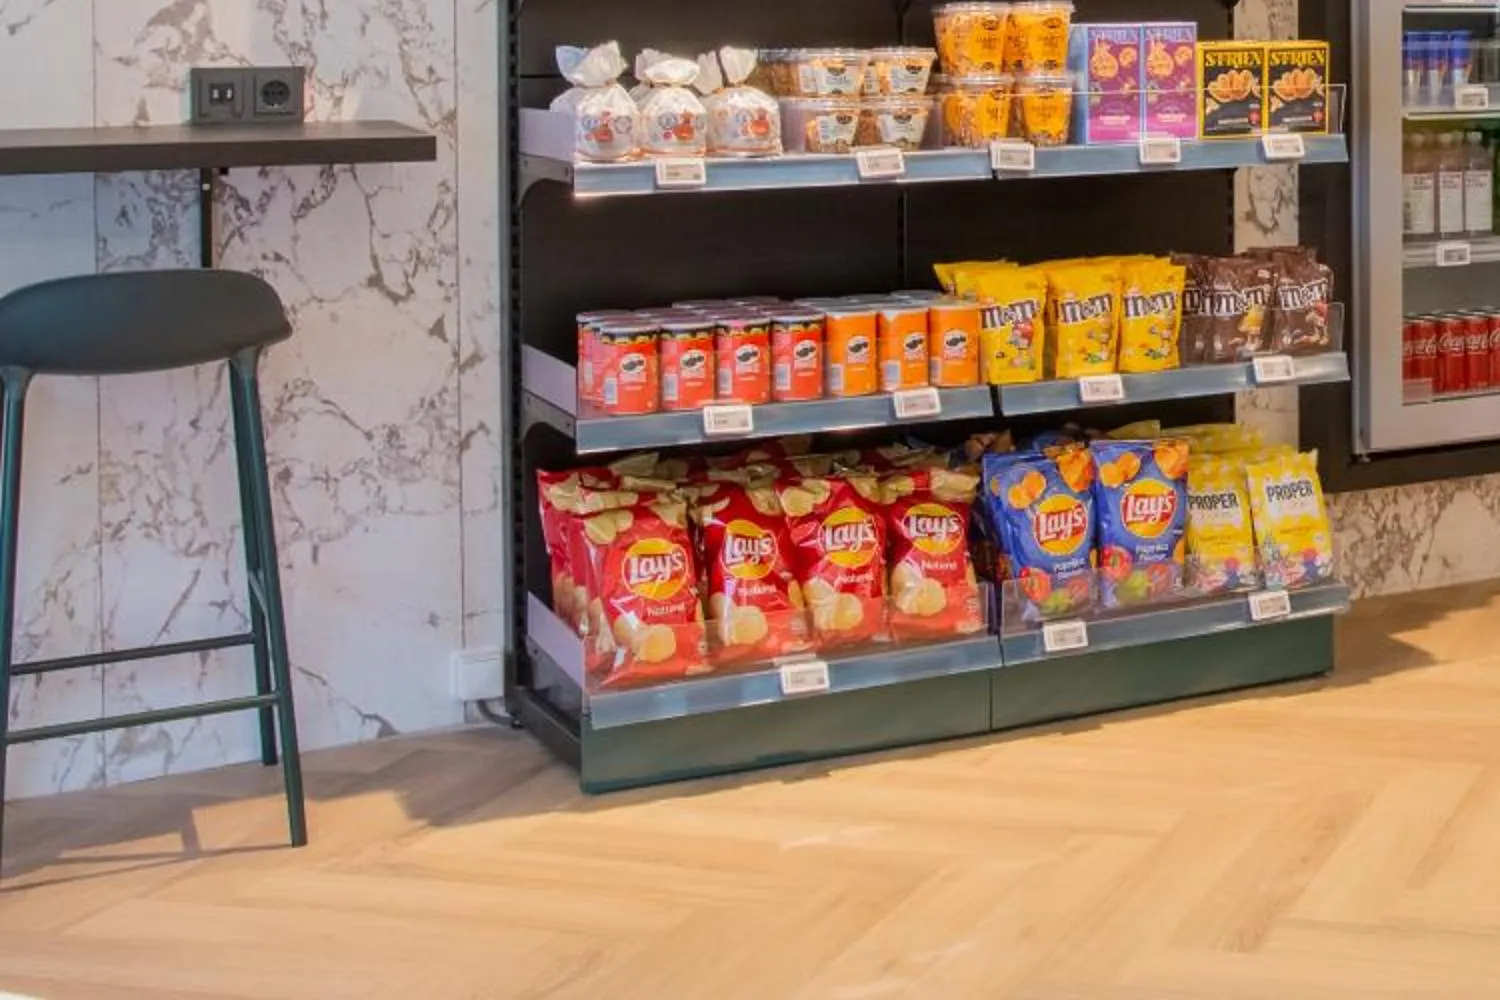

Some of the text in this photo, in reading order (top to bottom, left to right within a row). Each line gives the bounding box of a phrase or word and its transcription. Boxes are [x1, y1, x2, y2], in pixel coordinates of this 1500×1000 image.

[1125, 490, 1174, 523] Lay's
[1187, 492, 1239, 511] PROPER
[1265, 479, 1313, 502] PROPER
[825, 518, 876, 553] Lay's
[908, 512, 961, 542] Lay's
[1039, 503, 1085, 541] Lay's
[725, 533, 773, 565] Lay's
[628, 551, 685, 585] Lay's
